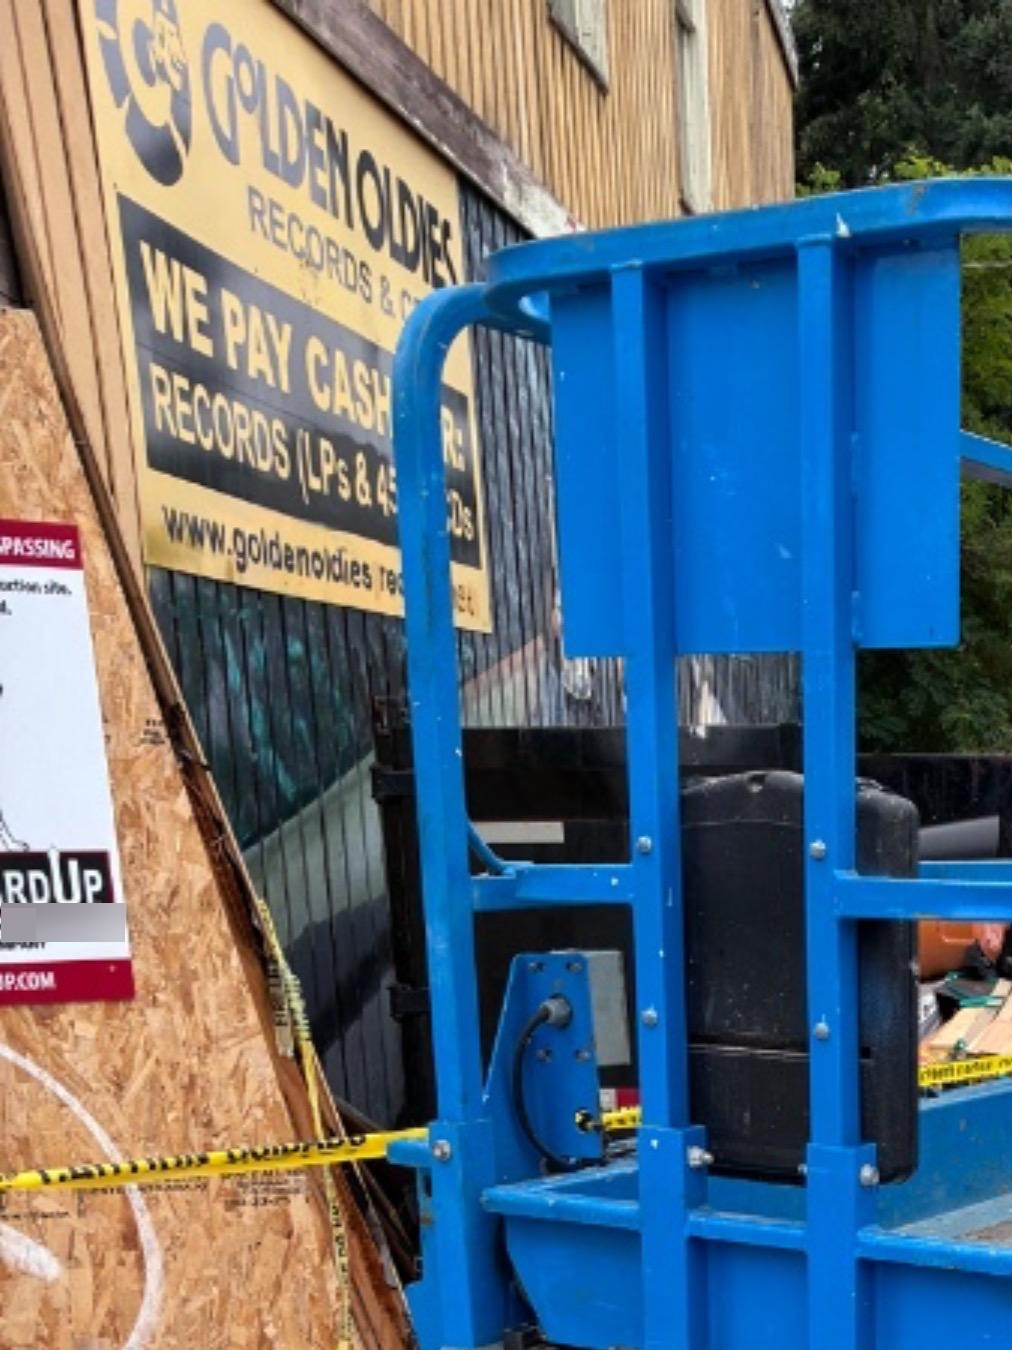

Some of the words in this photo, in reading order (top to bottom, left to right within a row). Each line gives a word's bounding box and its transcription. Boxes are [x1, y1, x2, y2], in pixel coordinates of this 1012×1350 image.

[247, 184, 373, 303] RECORDS
[380, 274, 396, 319] &
[140, 240, 213, 358] WE
[220, 288, 293, 393] PAY
[305, 335, 393, 437] CASH
[149, 362, 291, 480] RECORDS
[298, 428, 350, 504] (LPs
[356, 452, 373, 506] &
[0, 536, 75, 560] PASSING
[0, 848, 103, 903] RDUP
[0, 971, 57, 991] P.COM
